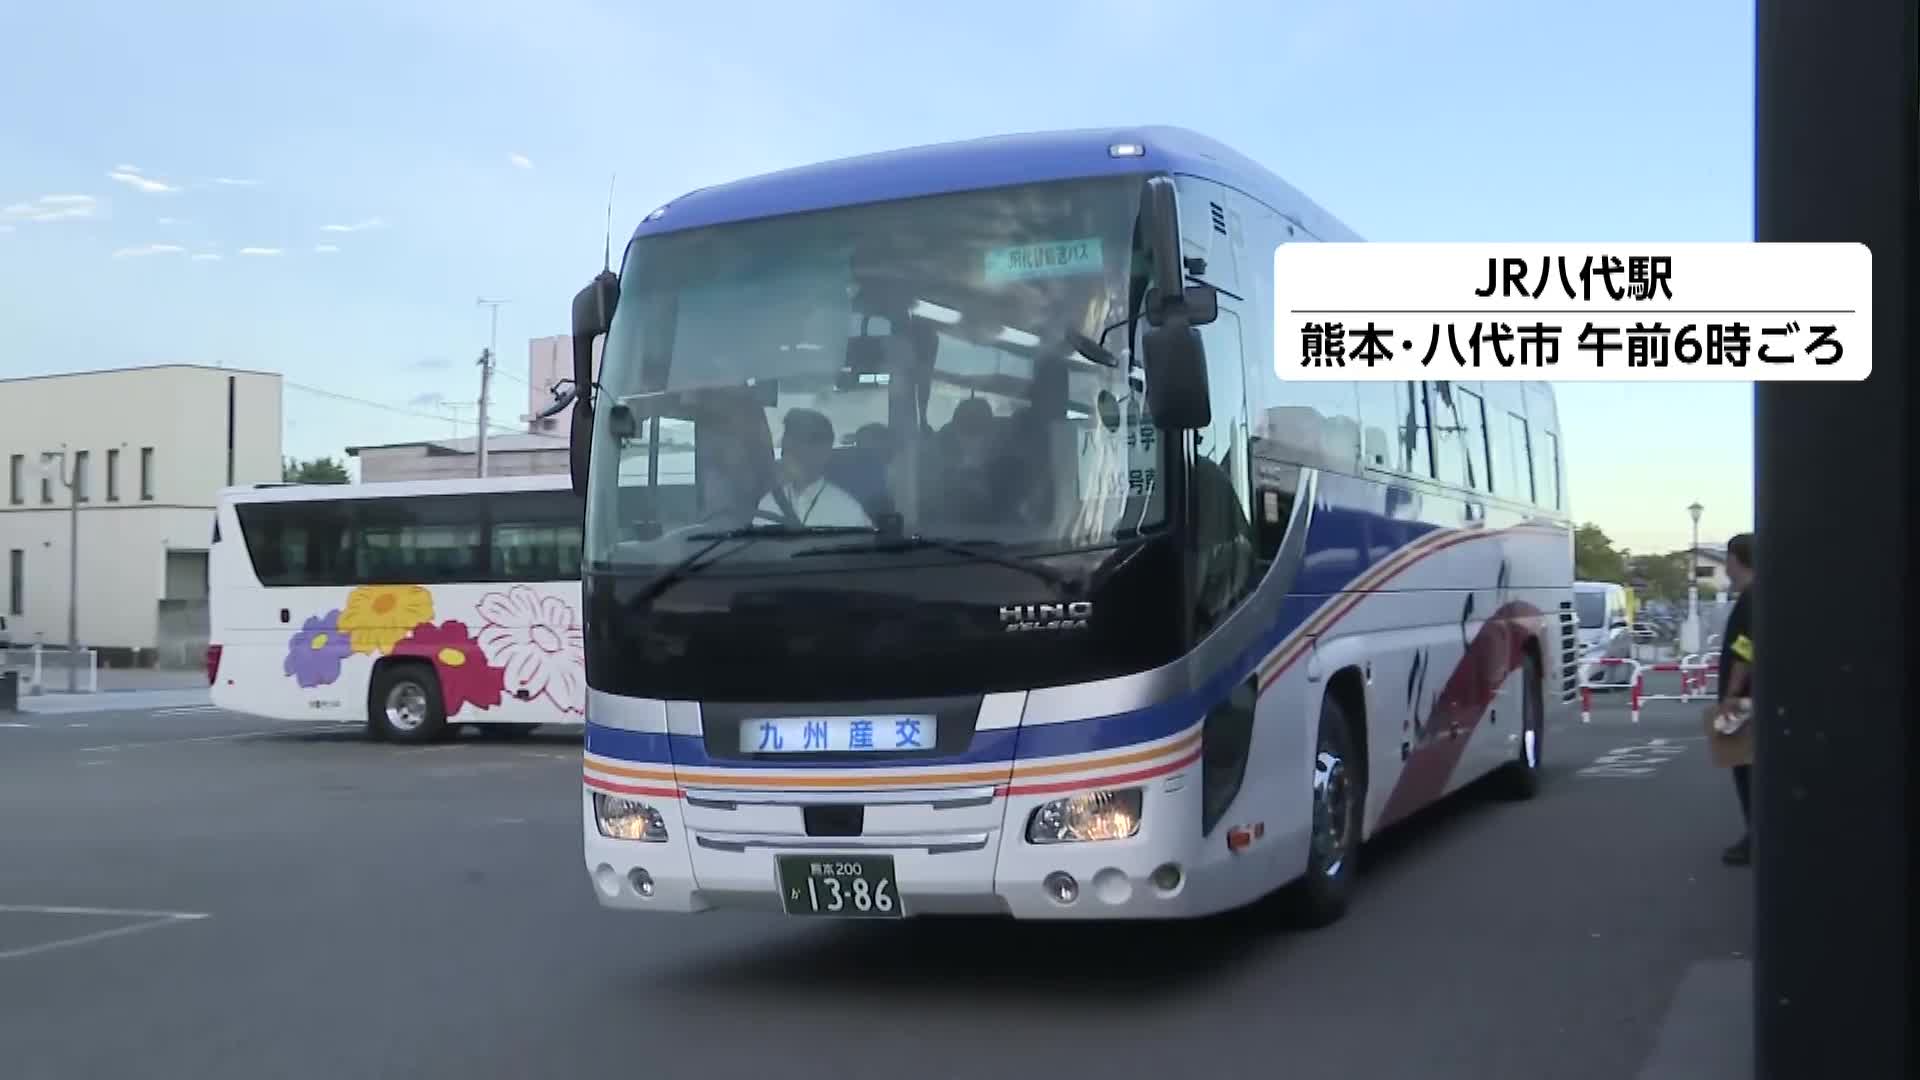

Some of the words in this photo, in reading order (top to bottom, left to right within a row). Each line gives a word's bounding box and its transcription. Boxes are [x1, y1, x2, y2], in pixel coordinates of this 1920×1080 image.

[999, 601, 1092, 621] HINO
[758, 718, 921, 750] 九州産交
